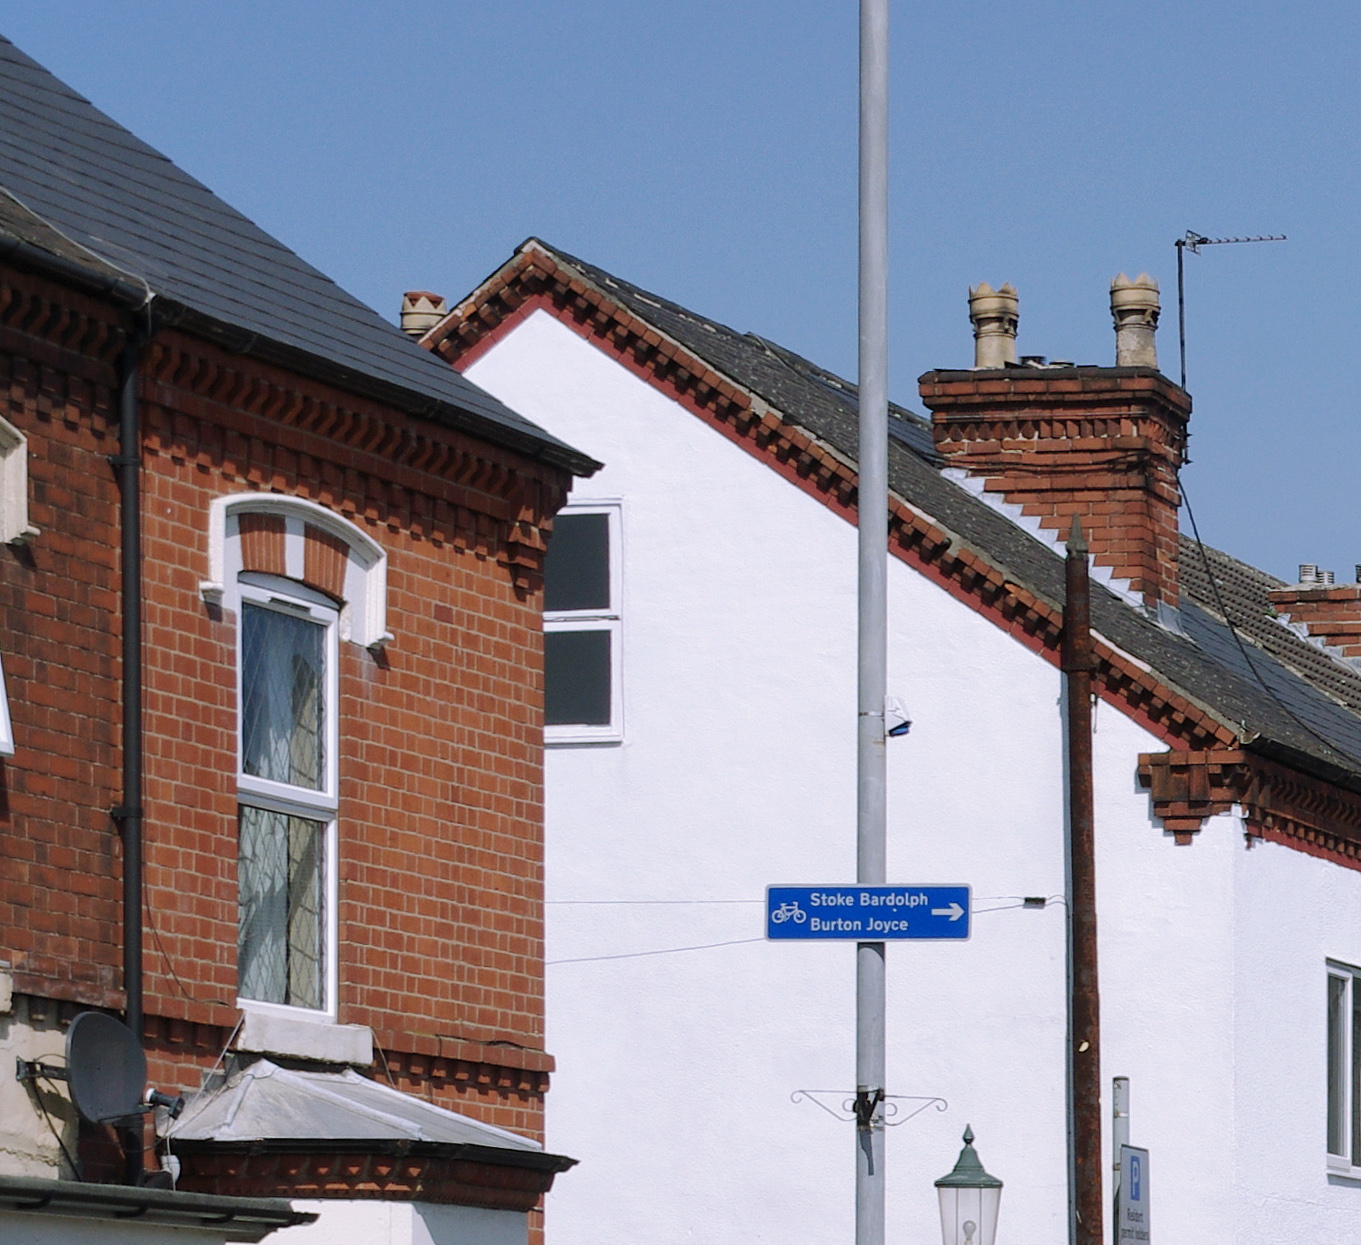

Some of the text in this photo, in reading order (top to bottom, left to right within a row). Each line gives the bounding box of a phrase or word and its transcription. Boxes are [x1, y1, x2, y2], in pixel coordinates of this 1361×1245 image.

[810, 893, 928, 908] Stoke Bardolph
[810, 918, 909, 933] Burton Joyce
